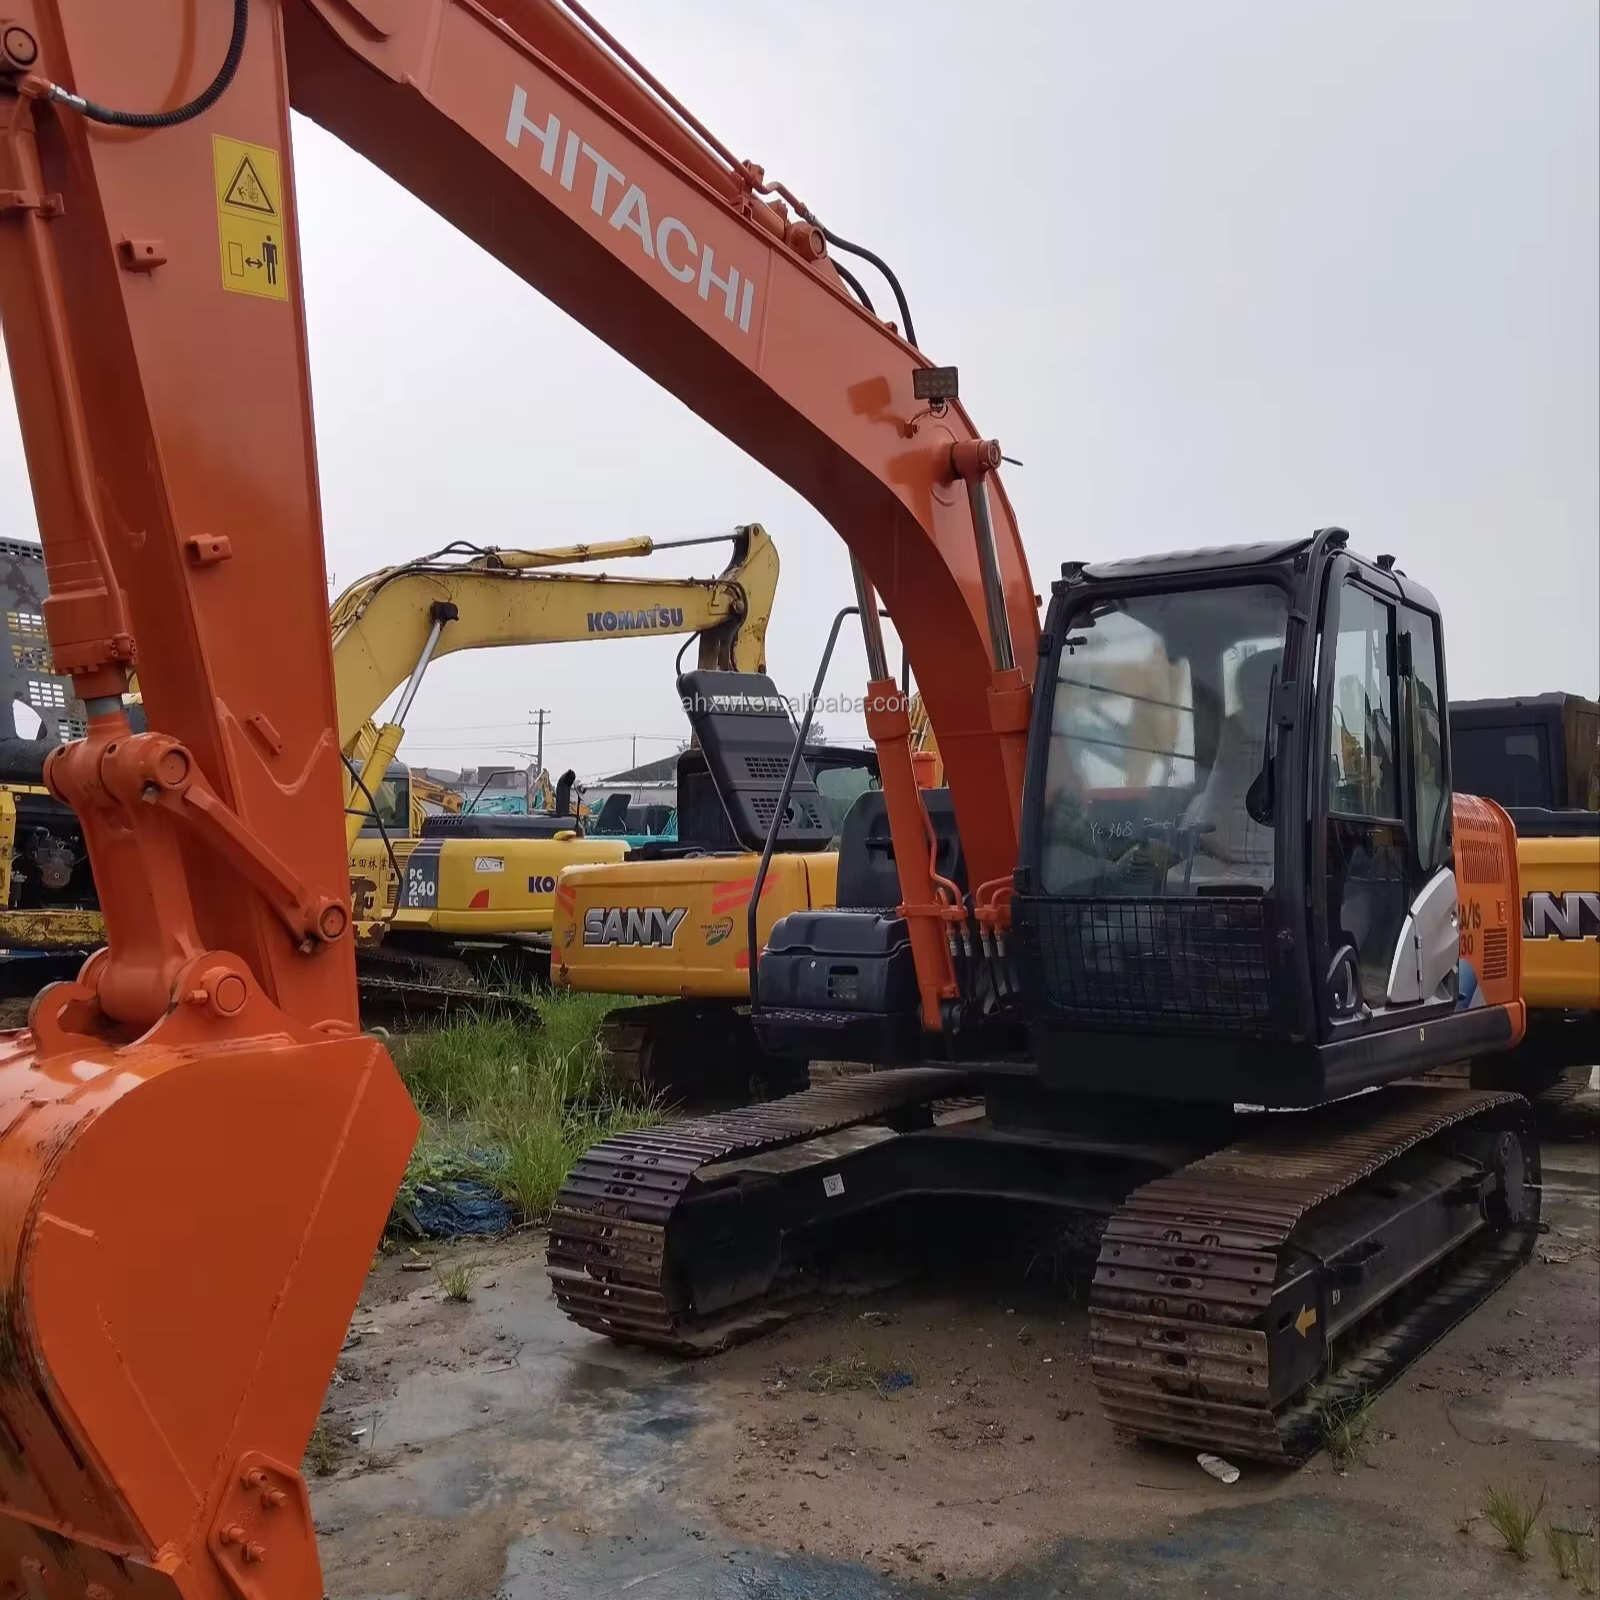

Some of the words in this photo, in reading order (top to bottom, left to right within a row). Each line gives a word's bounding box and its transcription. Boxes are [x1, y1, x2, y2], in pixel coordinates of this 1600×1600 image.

[505, 84, 754, 334] HITACHI
[586, 605, 684, 632] KOMATSU
[409, 868, 423, 880] PC
[409, 881, 435, 896] 240
[528, 876, 558, 893] KO
[408, 897, 419, 906] LC
[583, 906, 689, 948] SANY
[1459, 933, 1474, 956] 30
